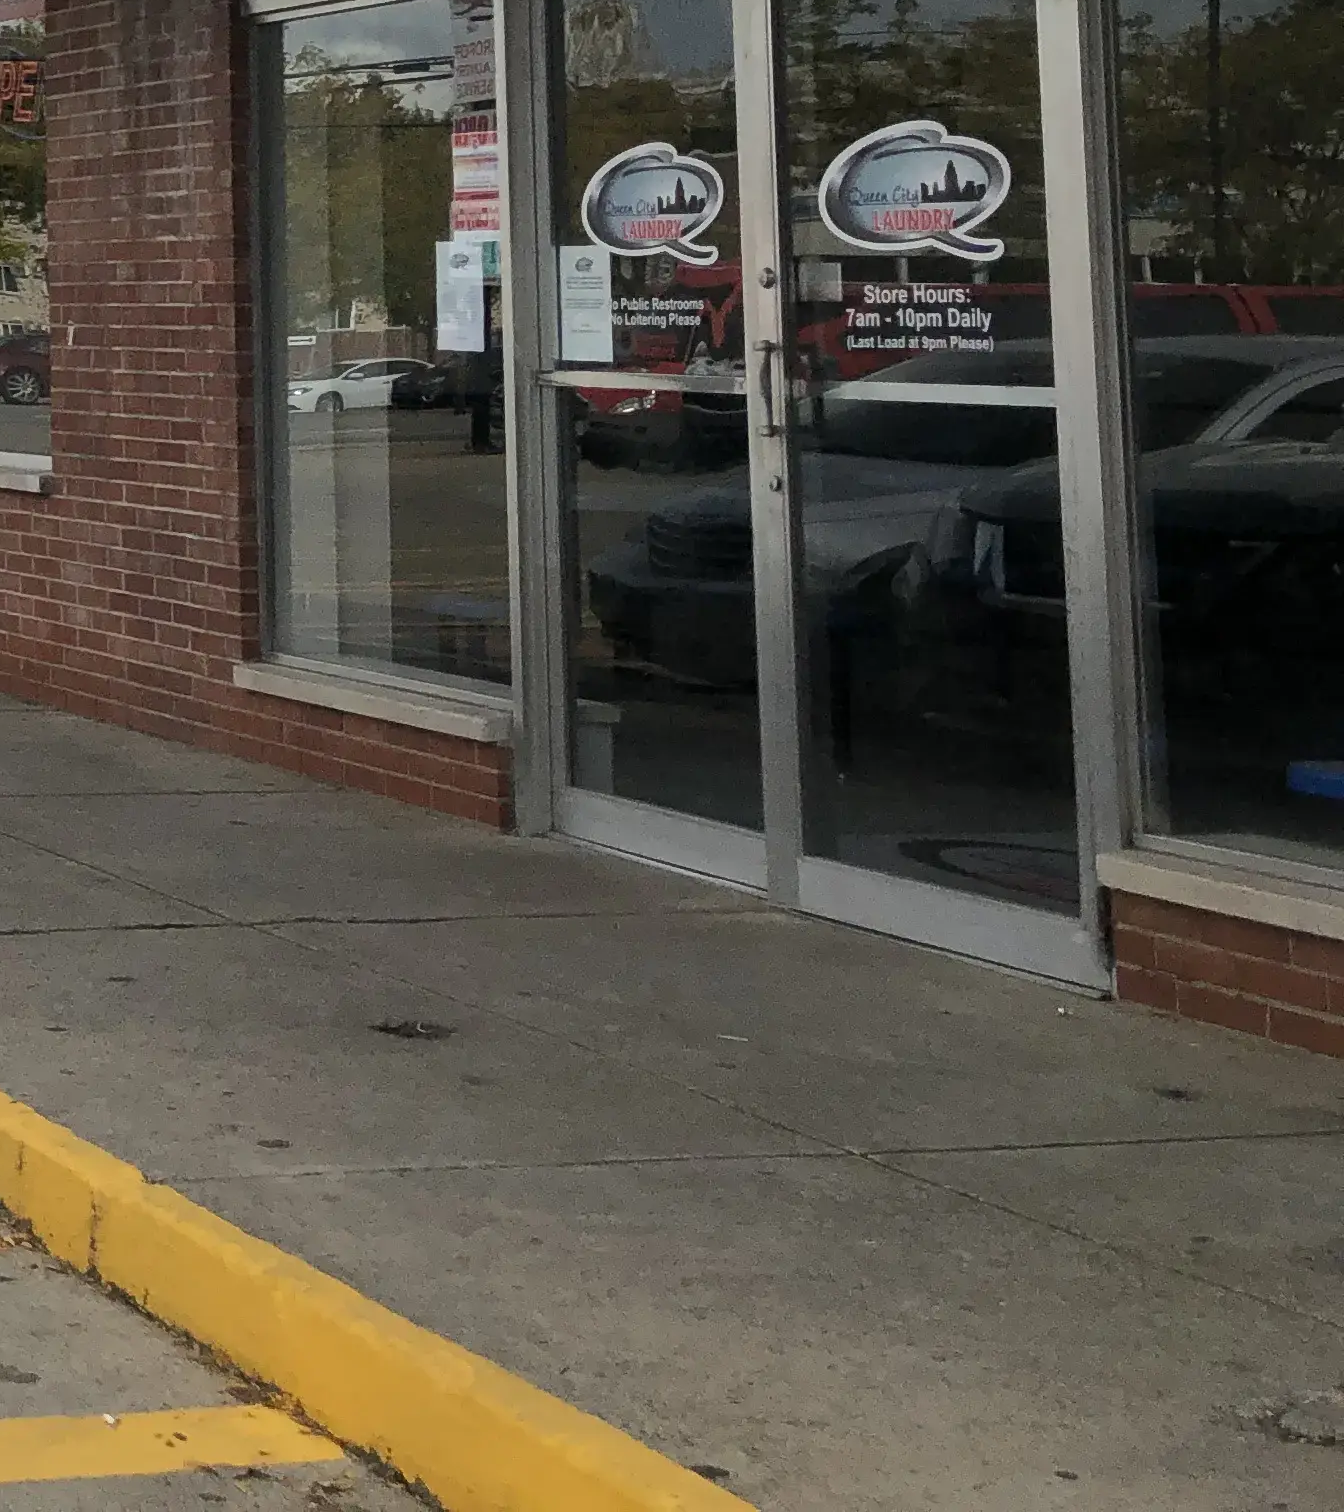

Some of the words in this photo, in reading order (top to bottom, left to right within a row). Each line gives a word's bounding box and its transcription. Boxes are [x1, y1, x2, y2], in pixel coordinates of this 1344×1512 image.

[847, 186, 889, 205] Queen
[892, 184, 921, 208] City
[604, 198, 634, 216] Queen
[636, 197, 657, 218] City
[622, 219, 683, 240] LAUNDRY
[872, 208, 957, 233] LAUNDRY
[620, 297, 650, 311] Public
[652, 297, 705, 311] Restrooms
[863, 284, 908, 304] Store
[912, 284, 972, 304] Hours:
[624, 313, 667, 329] Loitering
[668, 313, 701, 326] Please
[845, 308, 881, 328] 7am
[896, 307, 943, 332] 10pm
[947, 307, 992, 332] Daily
[846, 335, 874, 351] (Last
[877, 335, 906, 349] Load
[908, 336, 919, 349] at
[921, 335, 948, 351] 9pm
[949, 335, 994, 352] Please)
